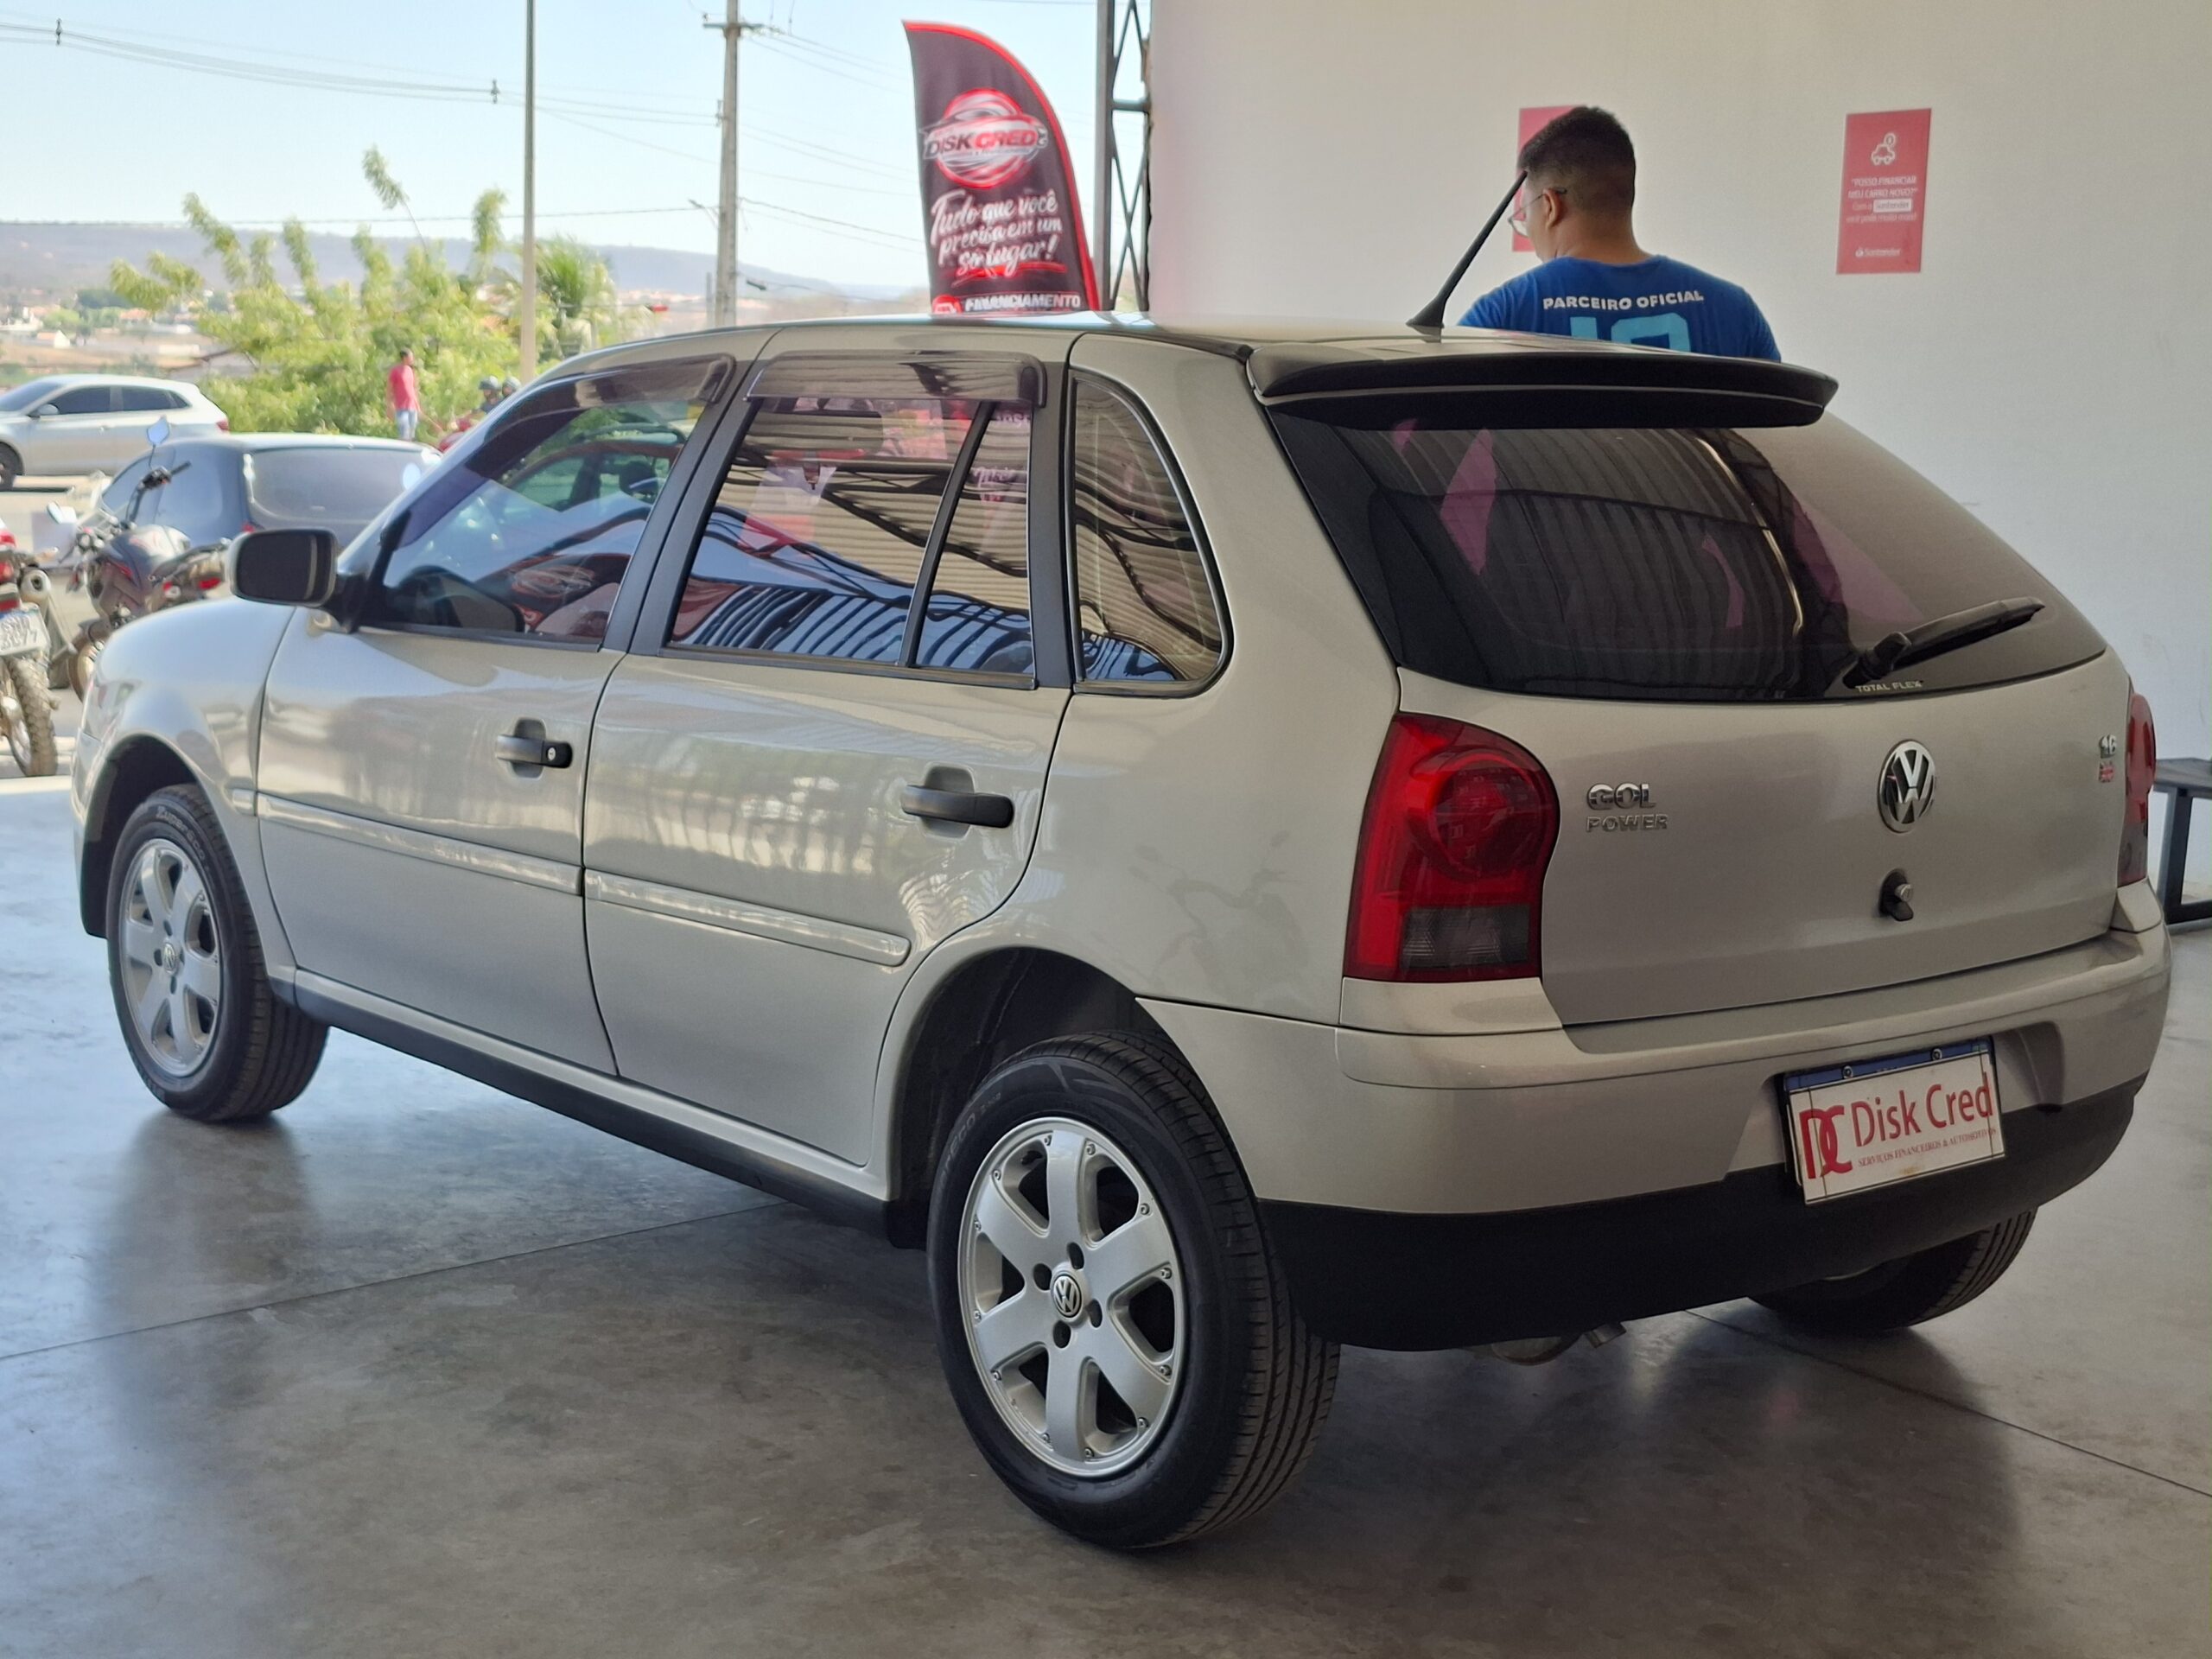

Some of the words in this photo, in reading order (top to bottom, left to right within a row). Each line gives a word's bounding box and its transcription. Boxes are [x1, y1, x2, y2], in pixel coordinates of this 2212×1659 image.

[931, 189, 982, 246] Tudo
[982, 200, 1016, 226] que
[1018, 188, 1058, 217] você
[938, 224, 1007, 268] precisa
[1007, 219, 1034, 238] em
[1037, 218, 1063, 233] um
[964, 294, 1081, 312] FINANCIAMENTO
[1542, 296, 1633, 311] PARCEIRO
[1636, 289, 1705, 308] OFICIAL
[1854, 683, 1891, 692] TOTAL
[1891, 680, 1923, 690] FLEX
[1586, 781, 1657, 811] GOL
[1586, 813, 1669, 833] POWER
[1850, 1089, 1922, 1148] Disk
[1925, 1071, 1994, 1128] Cred
